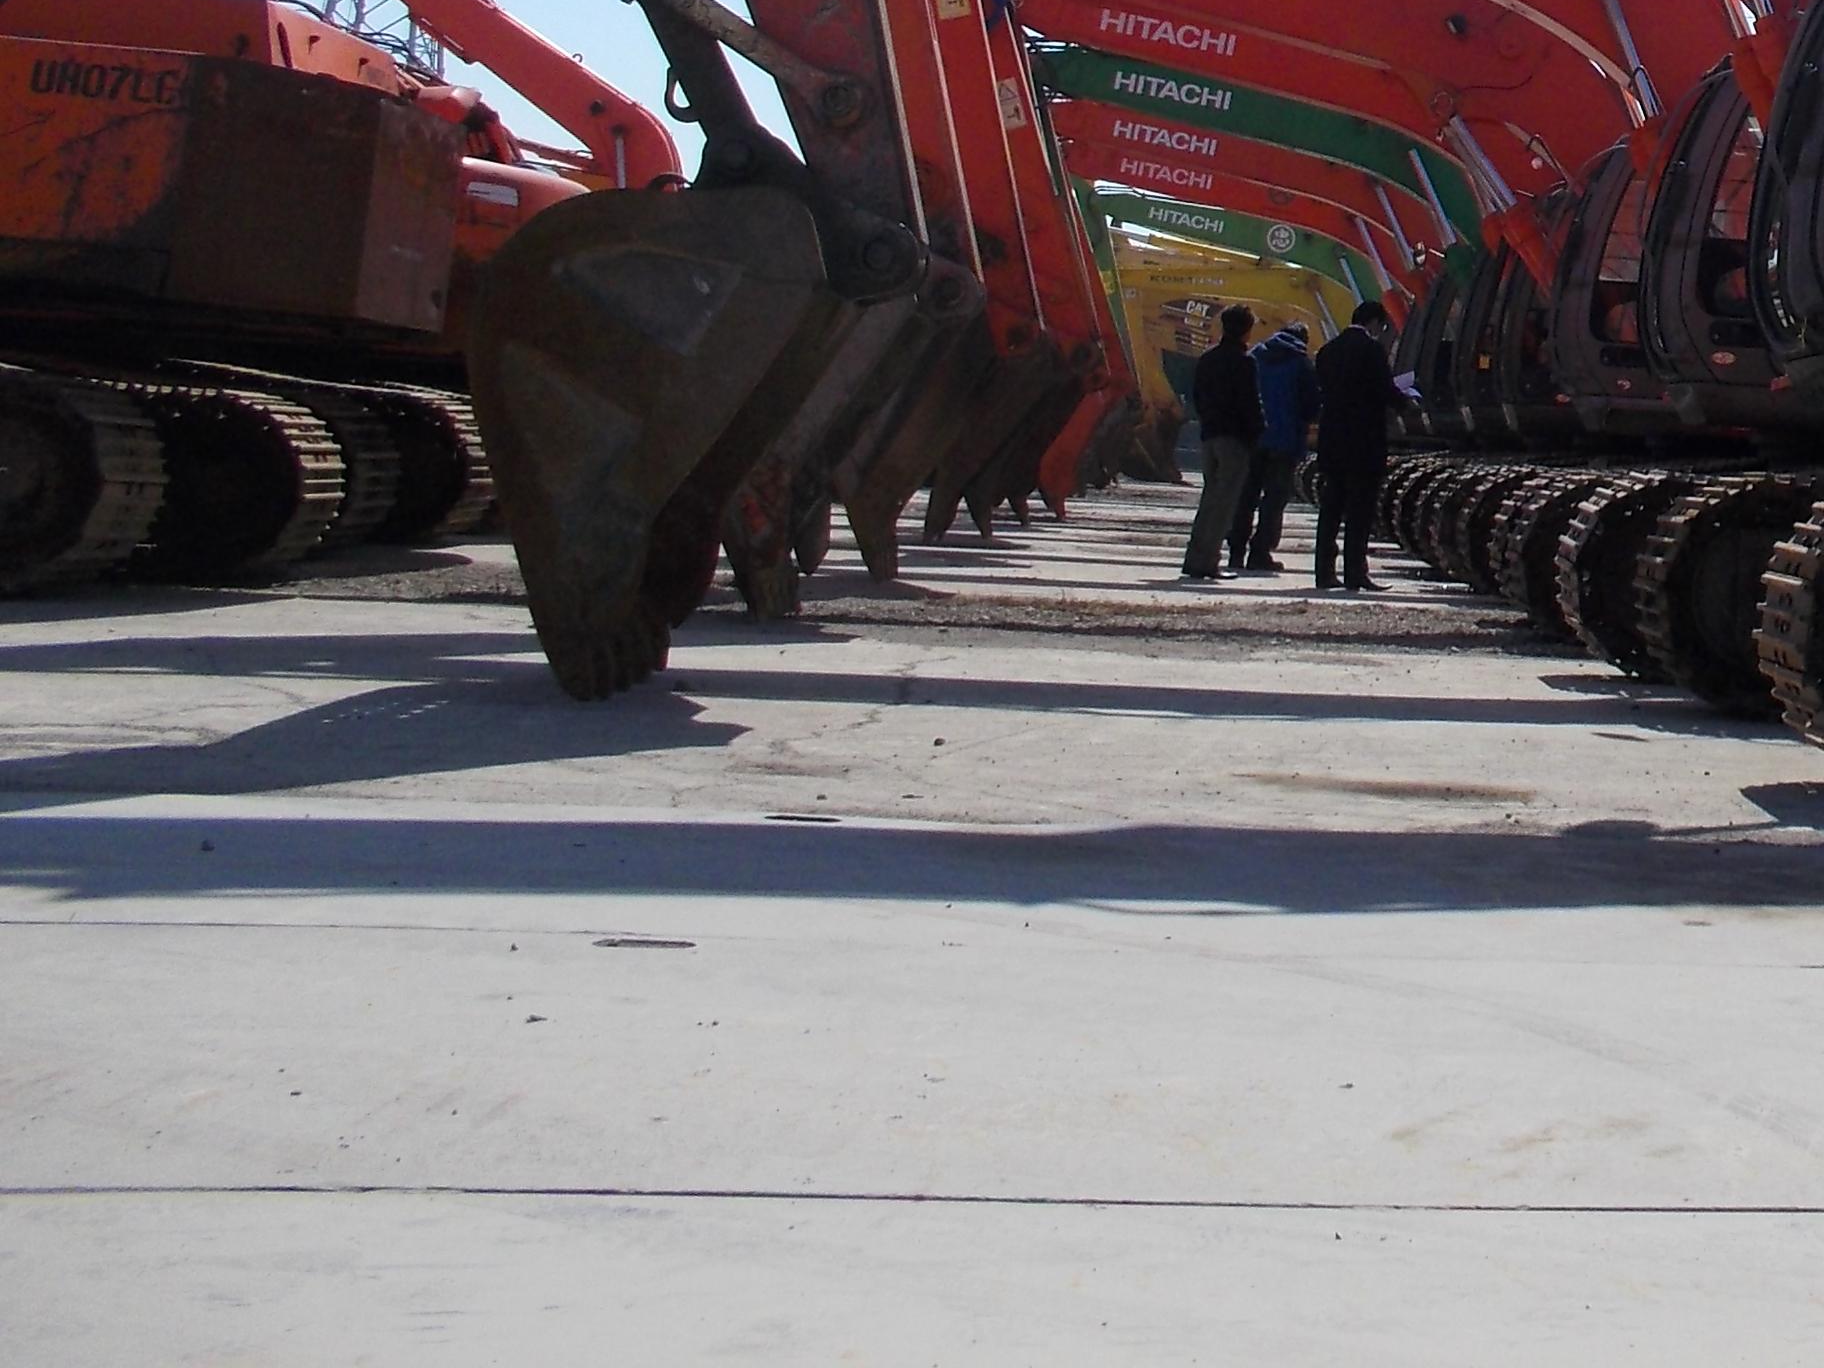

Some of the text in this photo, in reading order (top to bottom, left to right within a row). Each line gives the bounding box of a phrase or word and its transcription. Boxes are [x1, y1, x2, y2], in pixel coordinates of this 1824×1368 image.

[1099, 8, 1237, 57] HITACHI
[1114, 70, 1232, 111] HITACHI
[1113, 119, 1218, 157] HITACHI
[1120, 157, 1213, 191] HITACHI
[1148, 206, 1225, 234] HITACHI
[1186, 300, 1211, 317] CAT
